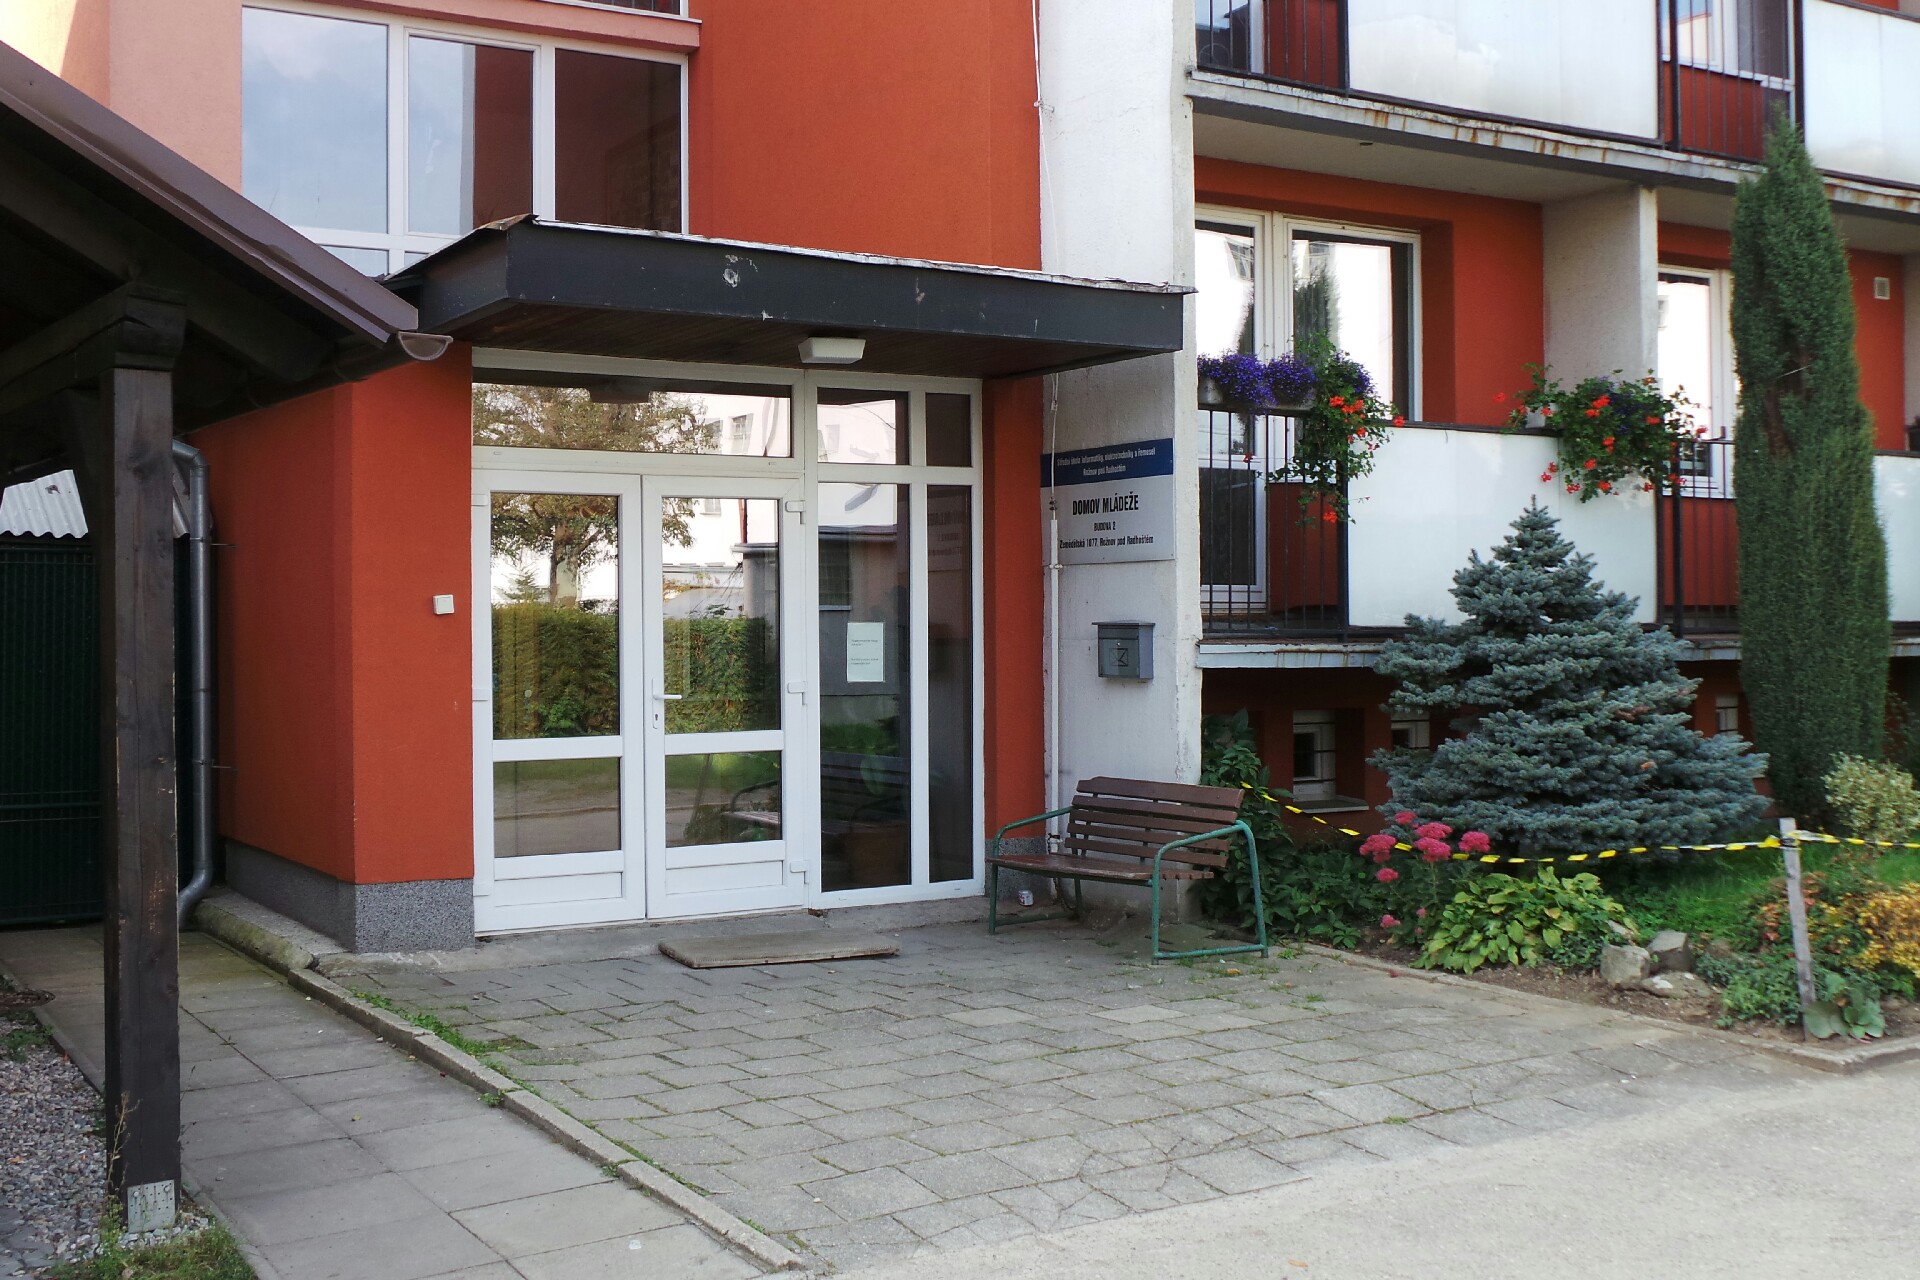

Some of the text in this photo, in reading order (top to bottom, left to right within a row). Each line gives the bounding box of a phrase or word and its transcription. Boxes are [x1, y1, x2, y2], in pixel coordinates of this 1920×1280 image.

[1072, 491, 1139, 515] DOMOV MLÁDEŽE
[1093, 521, 1116, 532] BUDOVA 2
[1100, 537, 1116, 546] Rožnov
[1117, 536, 1126, 547] pod
